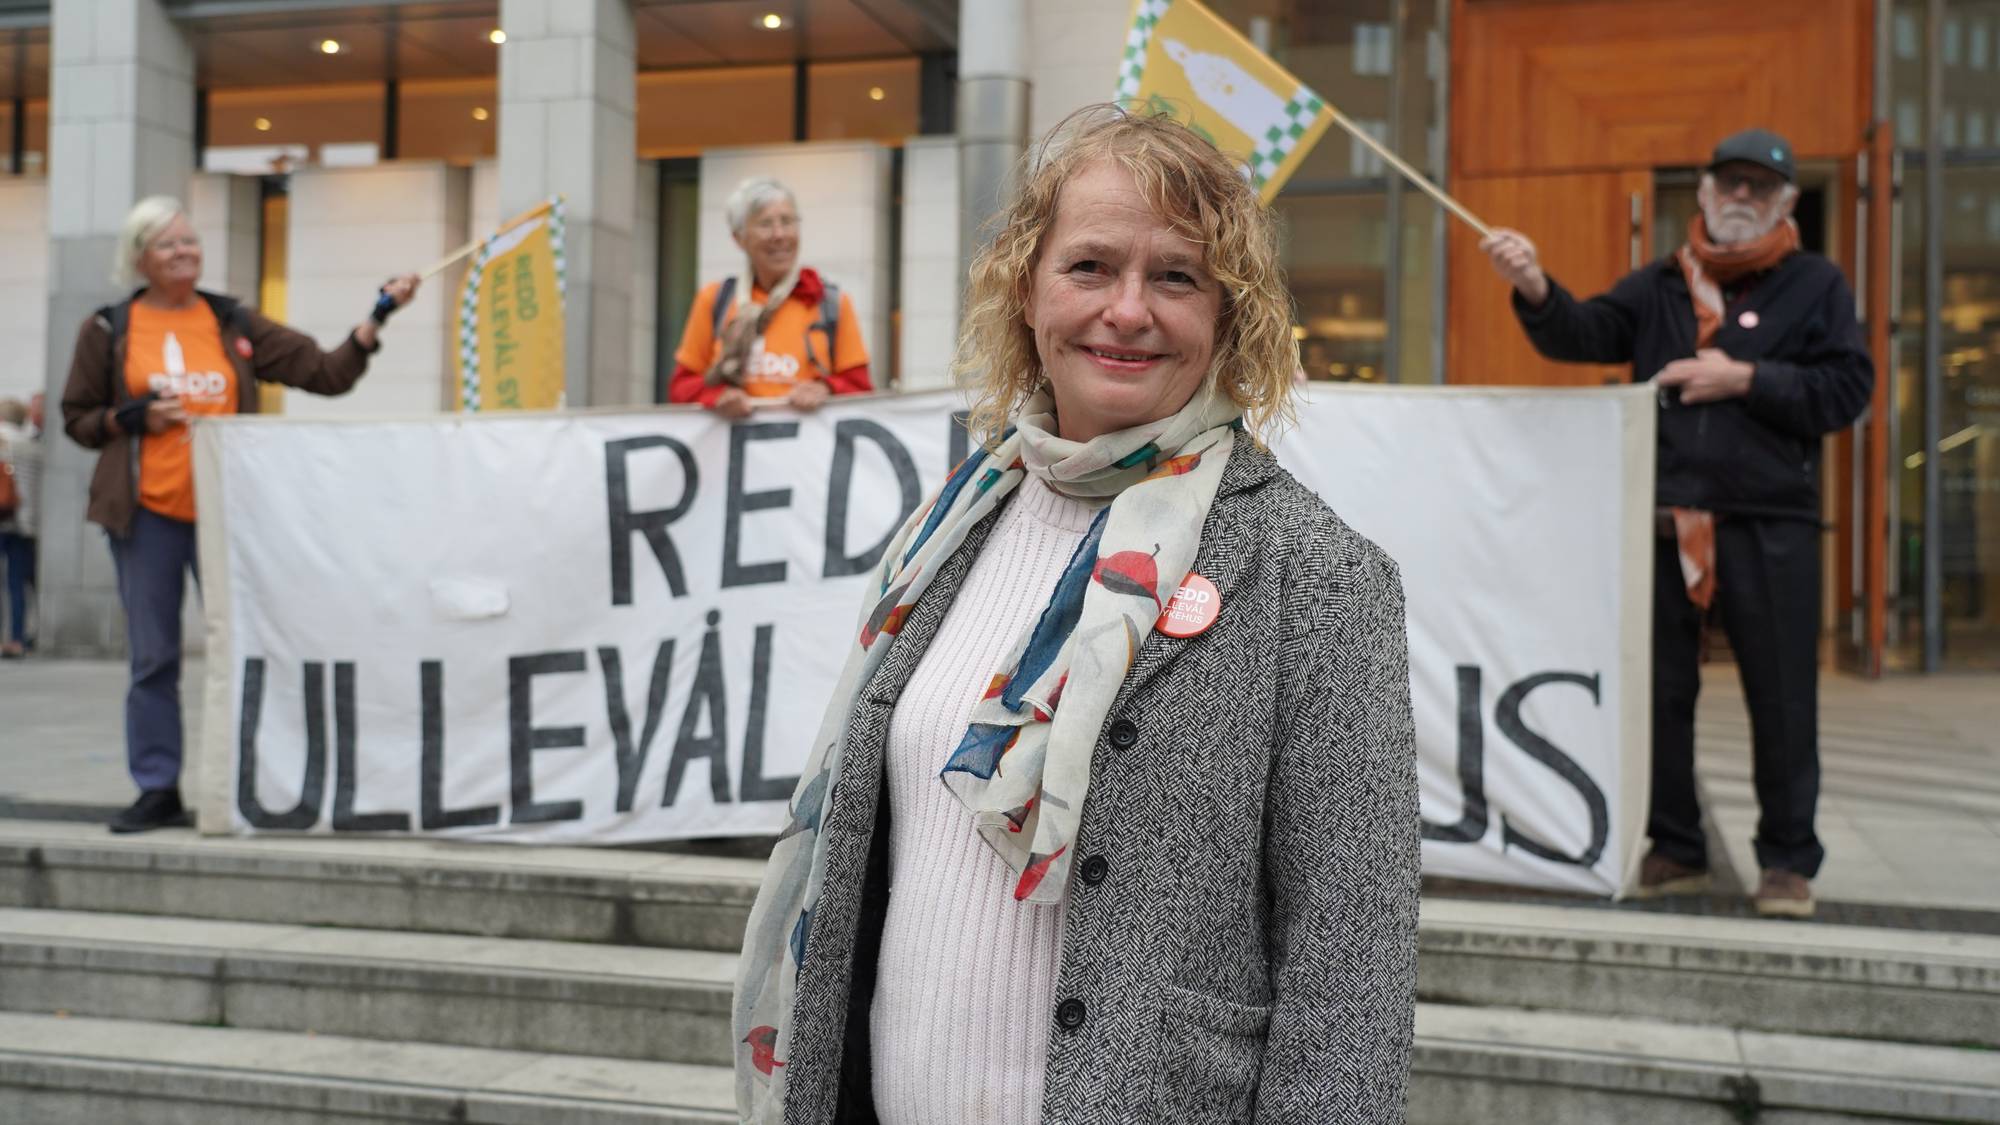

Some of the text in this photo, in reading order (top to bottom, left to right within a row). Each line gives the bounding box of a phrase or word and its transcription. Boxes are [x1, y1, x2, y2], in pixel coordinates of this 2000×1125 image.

[749, 351, 799, 377] EDD
[1173, 587, 1210, 604] EDD
[1160, 609, 1203, 624] YKEHUS
[1167, 601, 1205, 615] LEVÅL
[237, 609, 801, 833] ULLEVÅL
